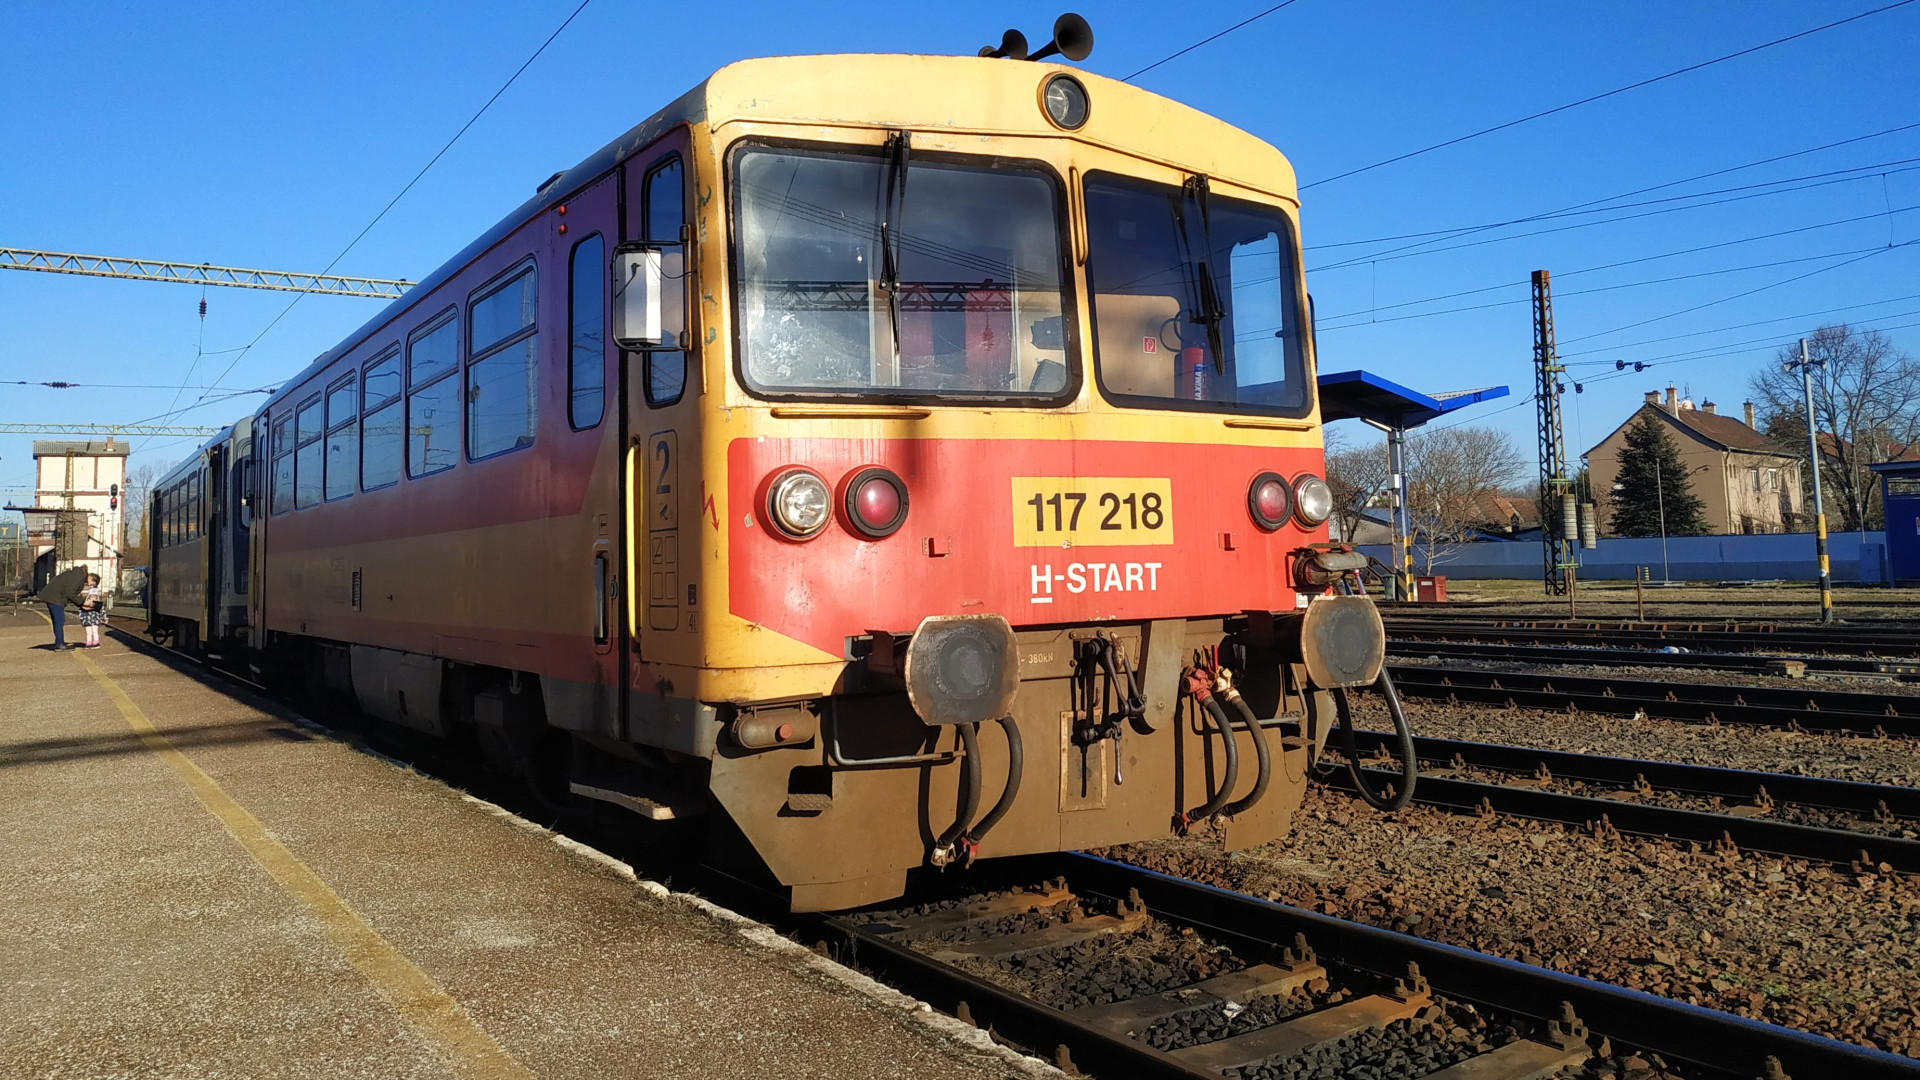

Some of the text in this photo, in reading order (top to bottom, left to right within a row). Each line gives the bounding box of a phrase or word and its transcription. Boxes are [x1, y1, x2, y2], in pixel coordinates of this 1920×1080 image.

[656, 440, 671, 495] 2
[1027, 492, 1164, 532] 117 218
[1030, 562, 1162, 603] H-START
